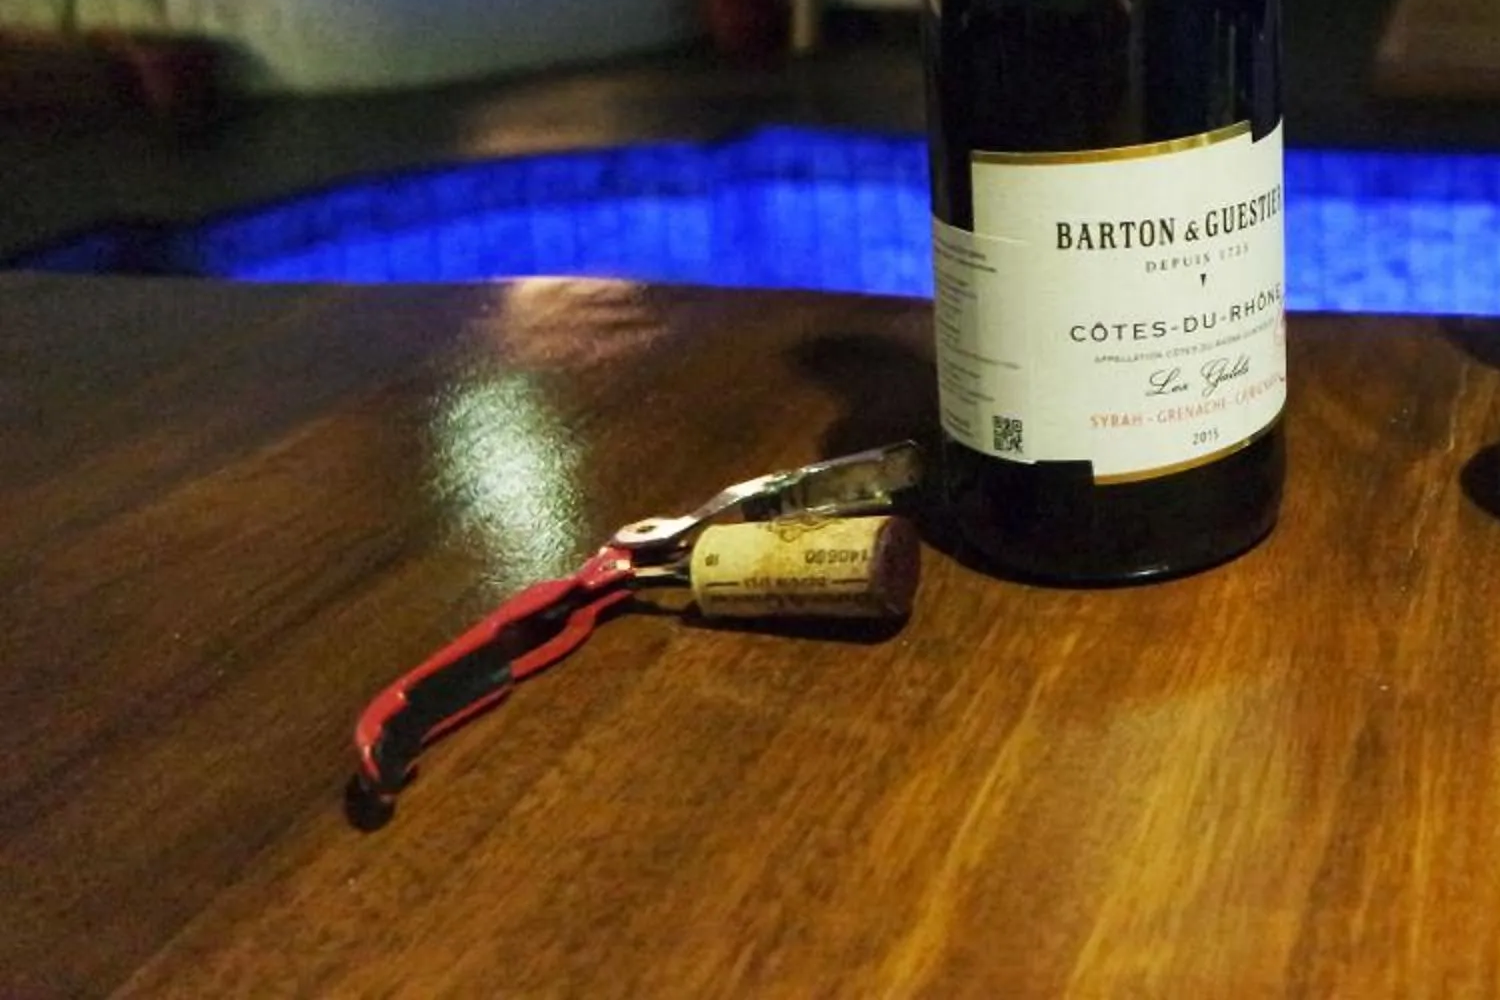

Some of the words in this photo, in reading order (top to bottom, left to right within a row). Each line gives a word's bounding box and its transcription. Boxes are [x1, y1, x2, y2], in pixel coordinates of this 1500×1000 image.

[1056, 217, 1175, 250] BARTON
[1185, 221, 1200, 242] &
[1145, 252, 1210, 273] DEPUIS
[1090, 412, 1143, 428] SYRAH
[1192, 428, 1219, 445] 2015
